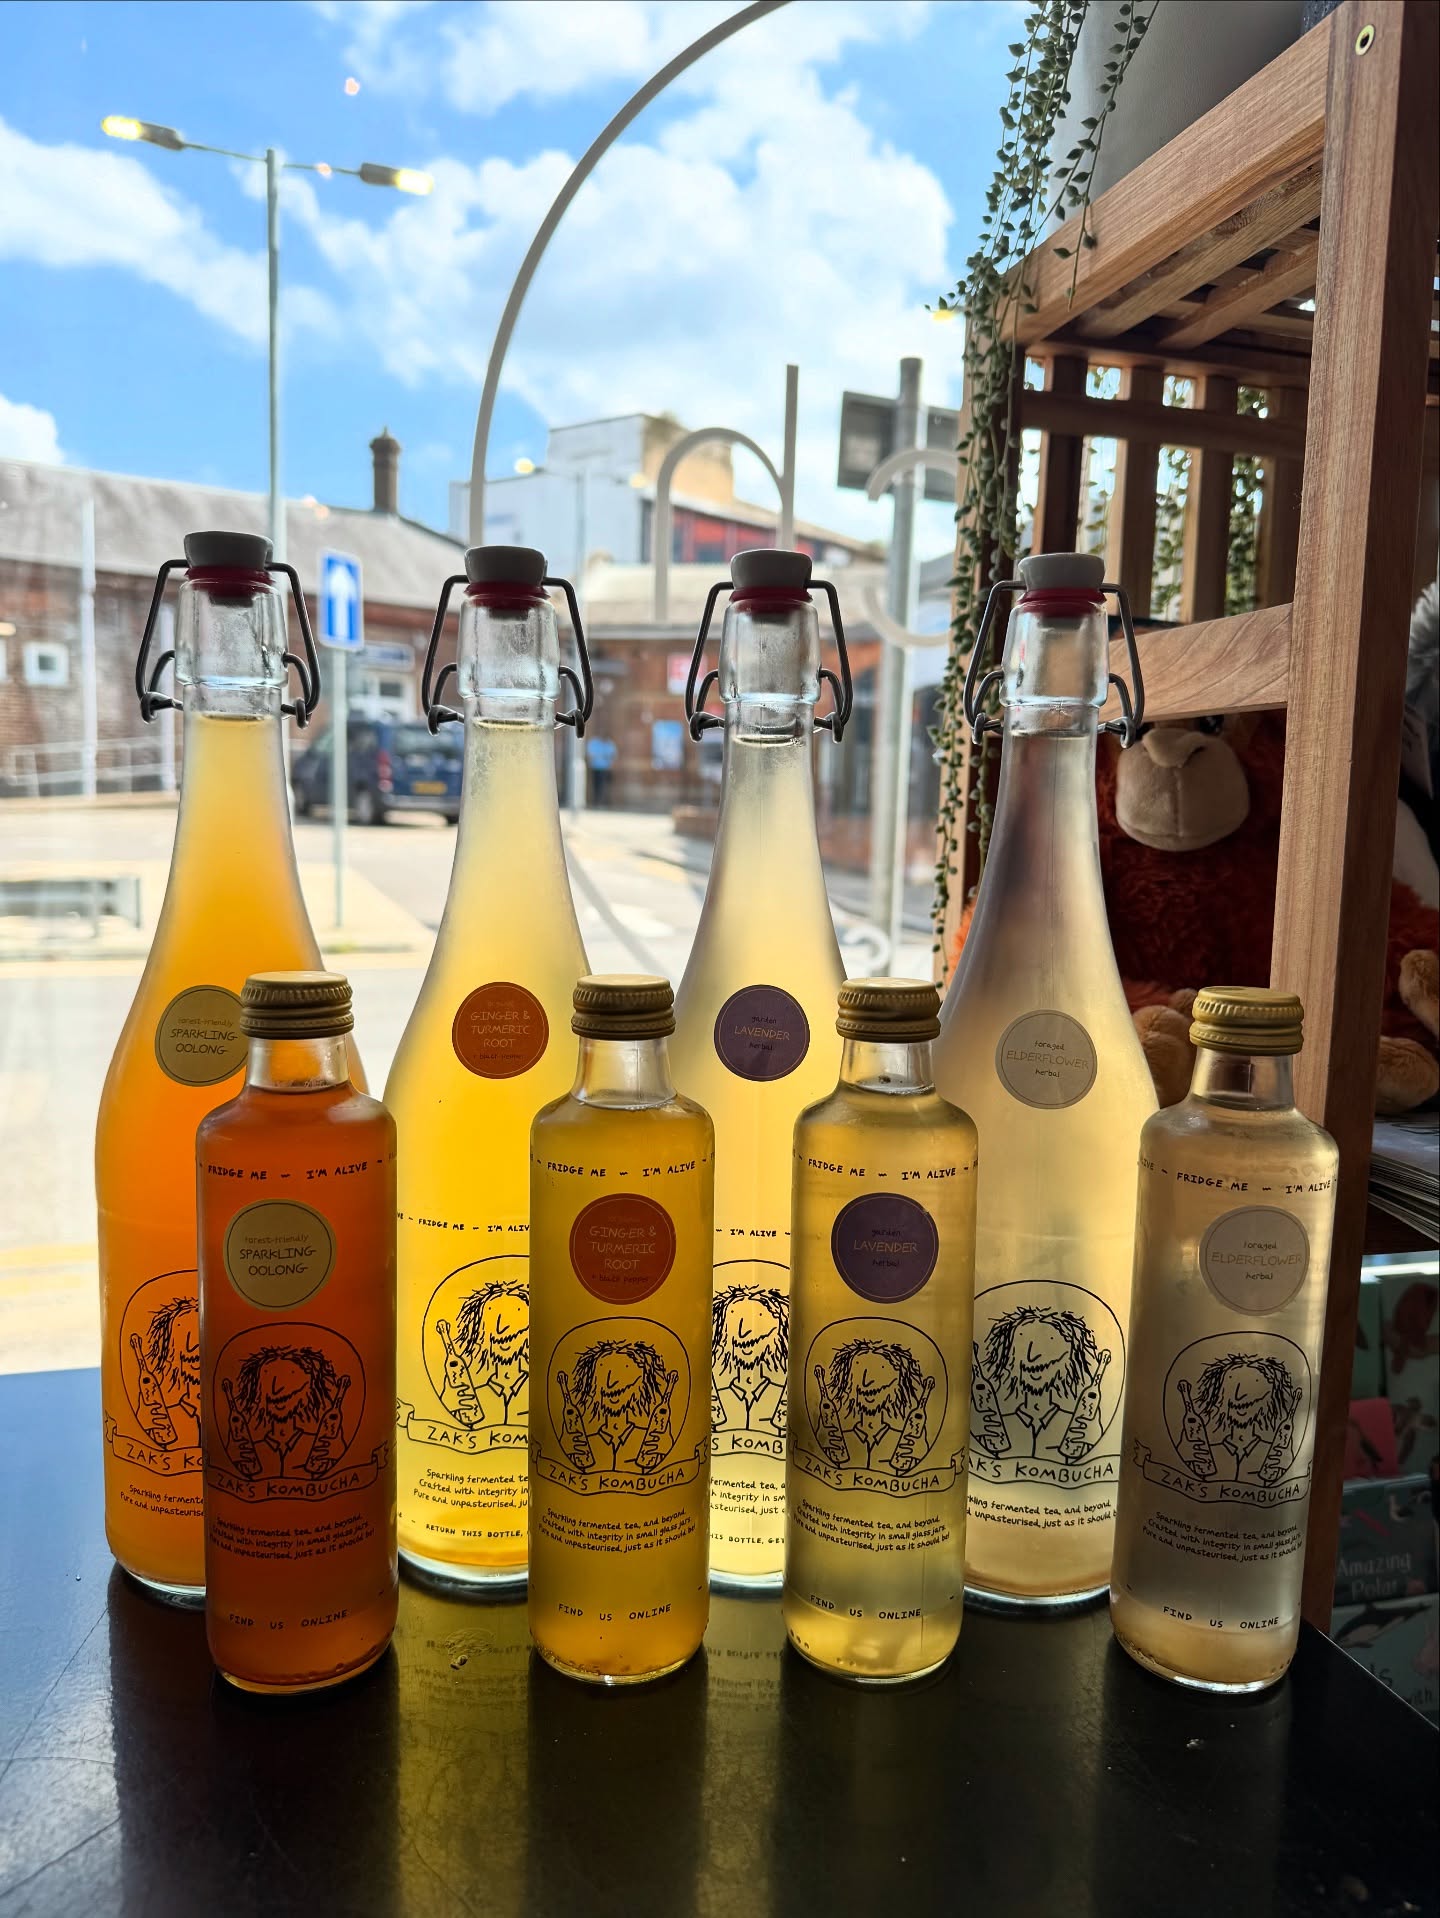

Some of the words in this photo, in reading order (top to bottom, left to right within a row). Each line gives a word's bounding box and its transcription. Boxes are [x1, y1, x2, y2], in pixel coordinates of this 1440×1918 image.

[471, 1011, 519, 1020] GINGER
[523, 1010, 530, 1019] &
[170, 1029, 238, 1041] SPARKLING
[471, 1025, 530, 1034] TURMERIC
[734, 1026, 791, 1040] LAVENDER
[176, 1043, 230, 1055] OOLONG
[484, 1039, 516, 1048] ROOT
[749, 1042, 773, 1050] herbal
[1035, 1041, 1064, 1050] foraged
[1007, 1050, 1088, 1069] ELDERFLOWER
[1035, 1068, 1060, 1077] herbal
[208, 1165, 244, 1178] FRIDGE
[251, 1171, 267, 1180] ME
[306, 1170, 327, 1179] I'M
[335, 1162, 367, 1176] ALIVE
[548, 1162, 584, 1175] FRIDGE
[643, 1168, 661, 1176] I'M
[667, 1161, 695, 1174] ALIVE
[808, 1159, 843, 1173] FRIDGE
[850, 1168, 865, 1176] ME
[902, 1172, 920, 1180] I'M
[927, 1168, 956, 1178] ALIVE
[1177, 1172, 1223, 1187] FRIDGE
[1231, 1183, 1248, 1191] ME
[1286, 1185, 1302, 1194] I'M
[1308, 1180, 1331, 1192] ALIVE
[419, 1219, 448, 1228] FRIDGE
[590, 1226, 645, 1238] GINGER
[649, 1225, 656, 1236] &
[240, 1246, 317, 1259] SPARKLING
[592, 1242, 655, 1254] TURMERIC
[853, 1240, 919, 1253] LAVENDER
[1244, 1242, 1277, 1250] foraged
[605, 1259, 640, 1270] ROOT
[1208, 1251, 1302, 1265] ELDERFLOWER
[248, 1264, 308, 1276] OOLONG
[1246, 1271, 1273, 1280] herbal
[428, 1426, 476, 1448] ZAK'S
[127, 1443, 170, 1470] ZAK'S
[427, 1469, 464, 1484] Sparkling
[467, 1475, 514, 1483] fermented
[550, 1465, 588, 1490] ZAK'S
[600, 1468, 684, 1490] KOMBUCHA
[805, 1456, 842, 1485] ZAK'S
[854, 1473, 940, 1491] KOMBUCHA
[1015, 1461, 1113, 1482] KOMBUCHA
[218, 1473, 255, 1497] ZAK'S
[267, 1472, 359, 1497] KOMBUCHA
[419, 1479, 450, 1492] Crafted
[478, 1487, 517, 1497] integrity
[1161, 1470, 1208, 1498] ZAK'S
[1220, 1484, 1300, 1502] KOMBUCHA
[120, 1491, 133, 1504] Pure
[135, 1501, 148, 1509] and
[130, 1485, 161, 1500] Sparkling
[414, 1489, 429, 1500] Pure
[432, 1496, 447, 1504] and
[720, 1491, 759, 1502] integrity
[760, 1507, 778, 1515] just
[802, 1499, 830, 1519] Sparkling
[833, 1513, 873, 1528] fermented
[896, 1519, 911, 1528] and
[991, 1500, 1040, 1514] fermented
[1064, 1505, 1081, 1514] and
[547, 1508, 576, 1526] Sparkling
[579, 1518, 620, 1529] fermented
[643, 1518, 659, 1527] and
[797, 1507, 819, 1526] Crafted
[822, 1522, 838, 1532] with
[840, 1527, 876, 1540] integrity
[888, 1531, 910, 1540] small
[912, 1528, 930, 1540] glass
[1042, 1519, 1061, 1528] just
[1087, 1513, 1111, 1523] should
[1155, 1512, 1191, 1531] Sparkling
[1194, 1525, 1238, 1539] fermented
[1261, 1529, 1275, 1538] and
[248, 1528, 290, 1536] fermented
[315, 1523, 331, 1532] and
[426, 1524, 455, 1535] RETURN
[542, 1516, 565, 1532] Crafted
[568, 1528, 584, 1537] with
[588, 1533, 624, 1542] integrity
[636, 1528, 657, 1539] small
[659, 1522, 678, 1535] glass
[1148, 1518, 1178, 1538] Crafted
[1180, 1533, 1200, 1544] with
[1203, 1538, 1241, 1551] integrity
[1253, 1540, 1273, 1550] small
[256, 1540, 292, 1549] integrity
[551, 1534, 562, 1543] and
[624, 1544, 641, 1553] just
[665, 1531, 686, 1543] should
[805, 1525, 816, 1534] and
[875, 1544, 893, 1552] just
[917, 1538, 940, 1548] should
[1159, 1537, 1173, 1546] and
[1240, 1553, 1257, 1563] just
[1337, 1552, 1411, 1577] Amazing
[1352, 1578, 1397, 1599] Polar
[559, 1603, 583, 1616] FIND
[629, 1603, 672, 1619] ONLINE
[810, 1595, 835, 1609] FIND
[850, 1609, 862, 1617] US
[879, 1608, 921, 1619] ONLINE
[230, 1614, 253, 1626] FIND
[270, 1621, 284, 1630] US
[301, 1609, 348, 1628] ONLINE
[1163, 1606, 1192, 1620] FIND
[1210, 1619, 1223, 1628] US
[1240, 1617, 1279, 1629] ONLINE
